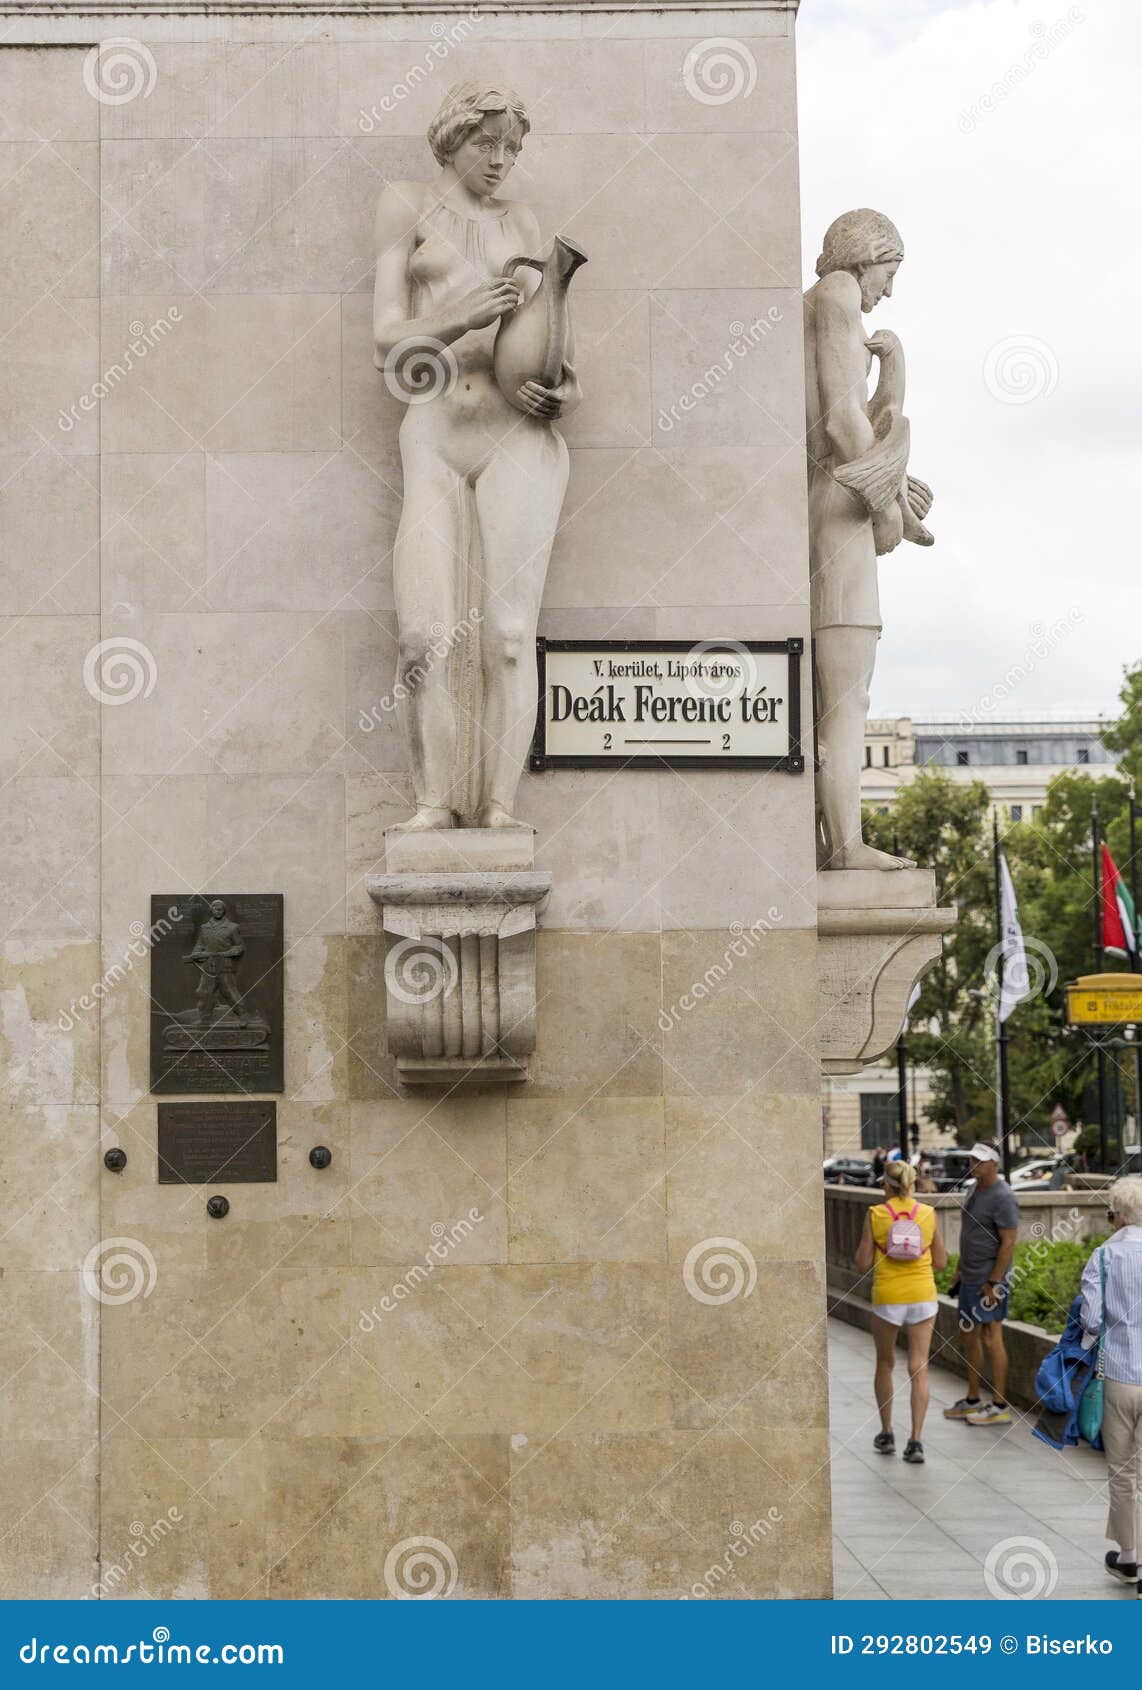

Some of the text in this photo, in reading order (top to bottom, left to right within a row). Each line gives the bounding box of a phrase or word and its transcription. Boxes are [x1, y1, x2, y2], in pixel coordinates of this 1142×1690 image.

[593, 660, 741, 681] V. kerület, Lipótváros
[551, 685, 783, 723] Deák Ferenc tér
[603, 733, 731, 749] 2 2
